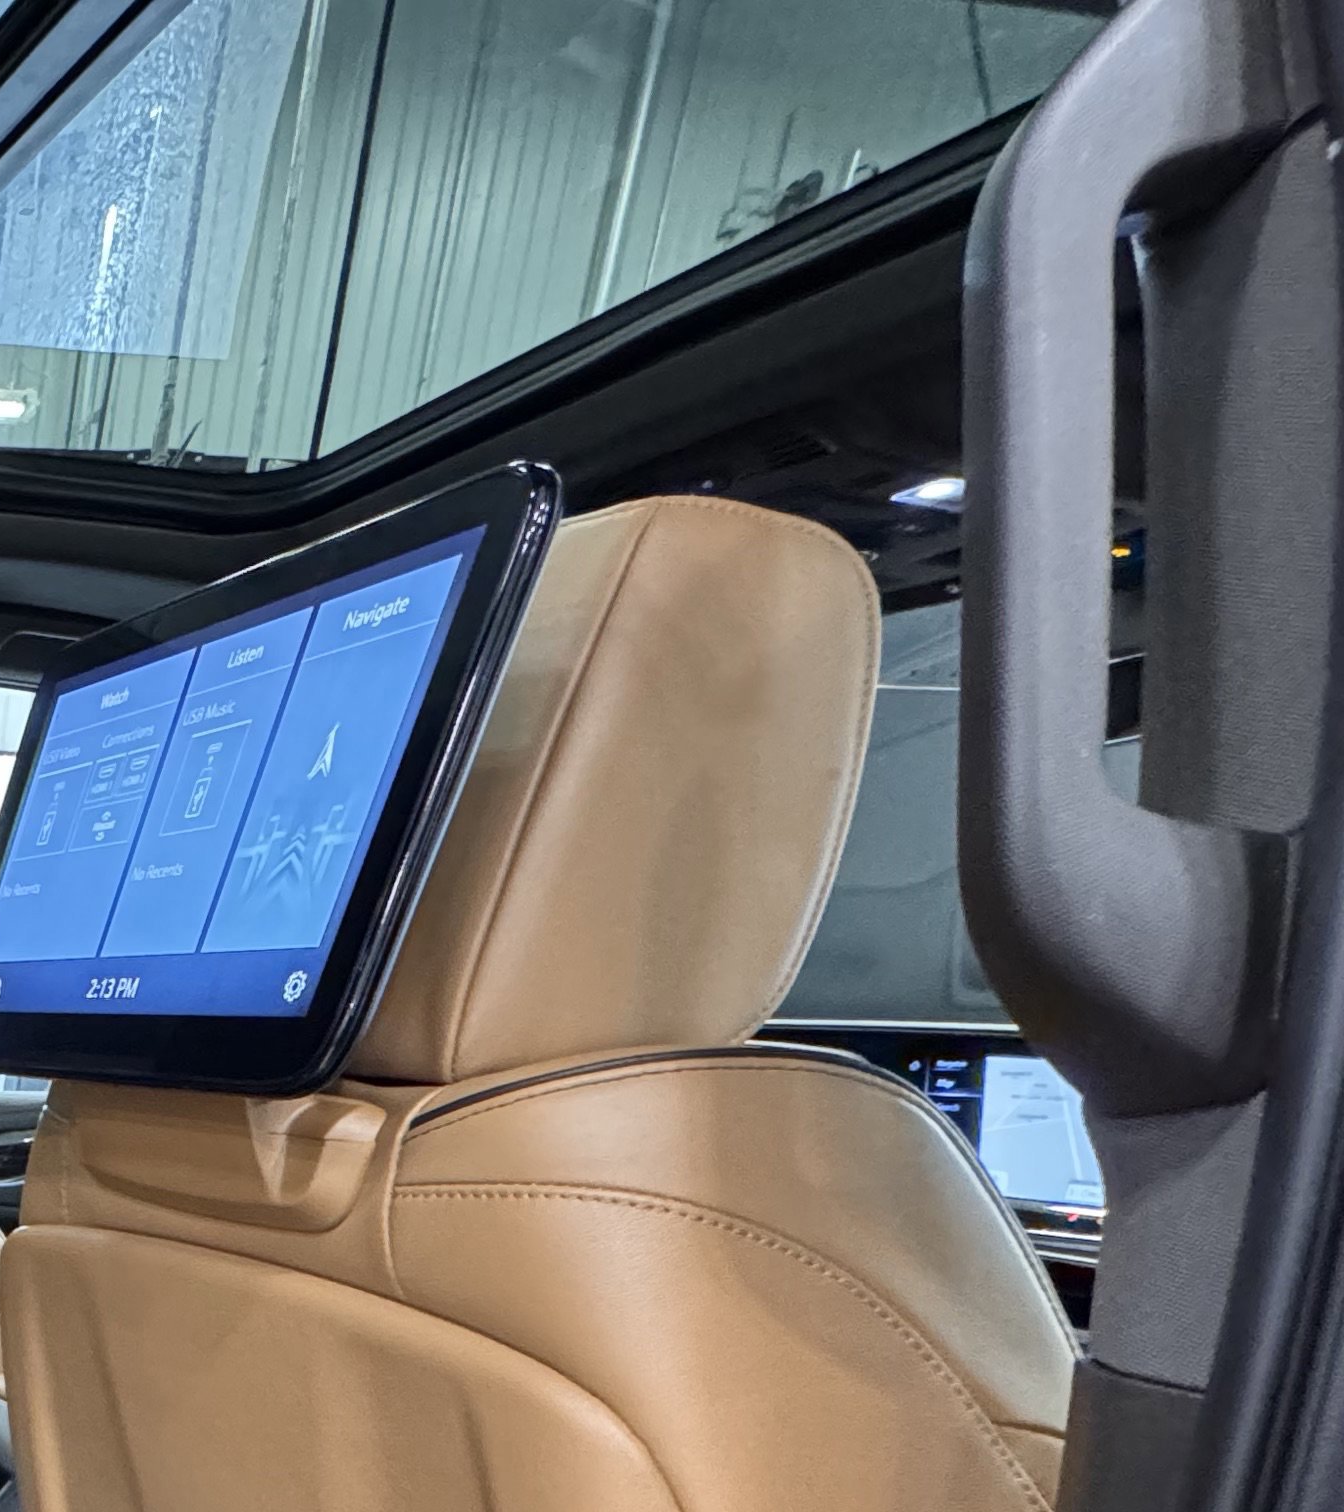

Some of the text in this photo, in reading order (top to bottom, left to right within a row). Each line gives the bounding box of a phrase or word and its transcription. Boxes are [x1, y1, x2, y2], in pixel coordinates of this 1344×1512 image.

[342, 596, 410, 632] Navigate
[227, 645, 265, 669] Listen
[101, 688, 130, 710] Watch
[183, 702, 236, 727] USB Music
[102, 725, 155, 748] Connections
[146, 863, 184, 880] Recents
[86, 977, 141, 999] 2:13 PM
